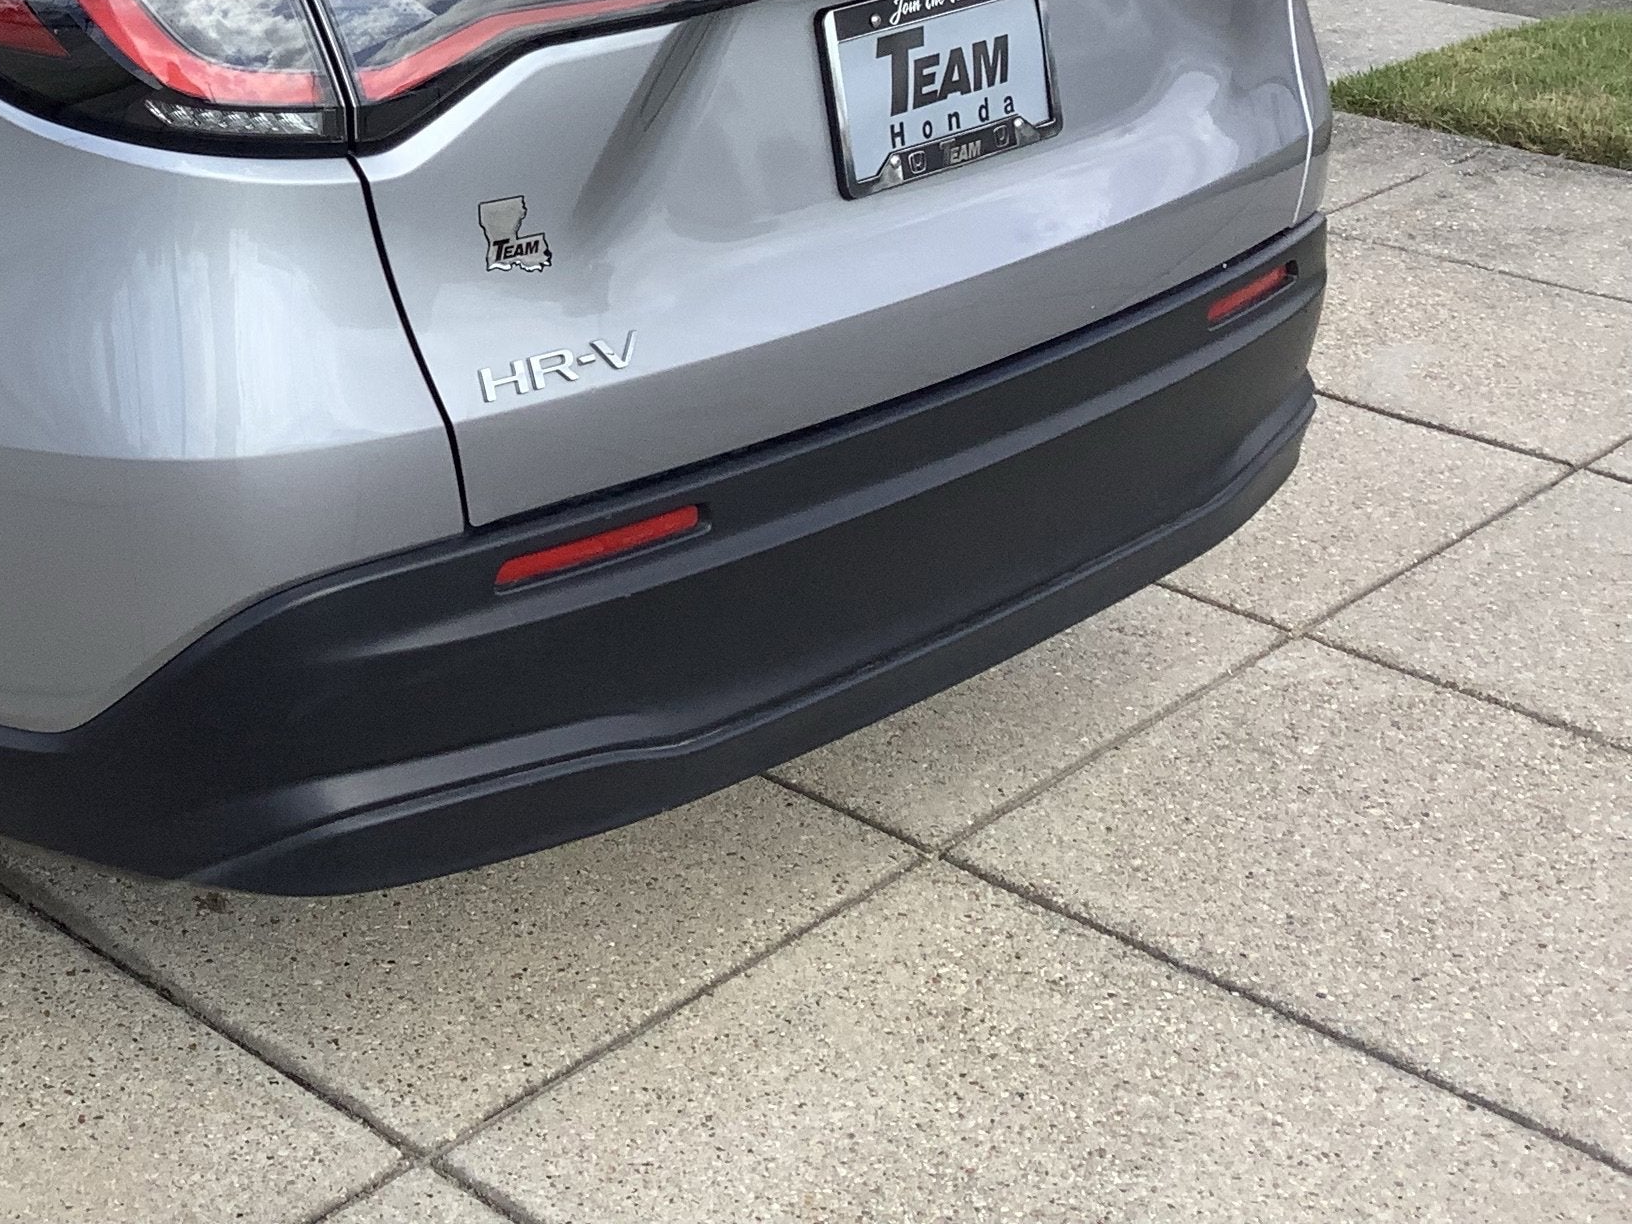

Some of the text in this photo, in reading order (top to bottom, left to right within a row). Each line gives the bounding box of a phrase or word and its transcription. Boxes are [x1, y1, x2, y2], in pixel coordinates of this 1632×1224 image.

[875, 25, 1010, 118] TEAM
[889, 94, 1016, 149] Honda
[939, 137, 982, 167] TEAM
[492, 238, 542, 263] TEAM
[477, 329, 638, 403] HR-V
